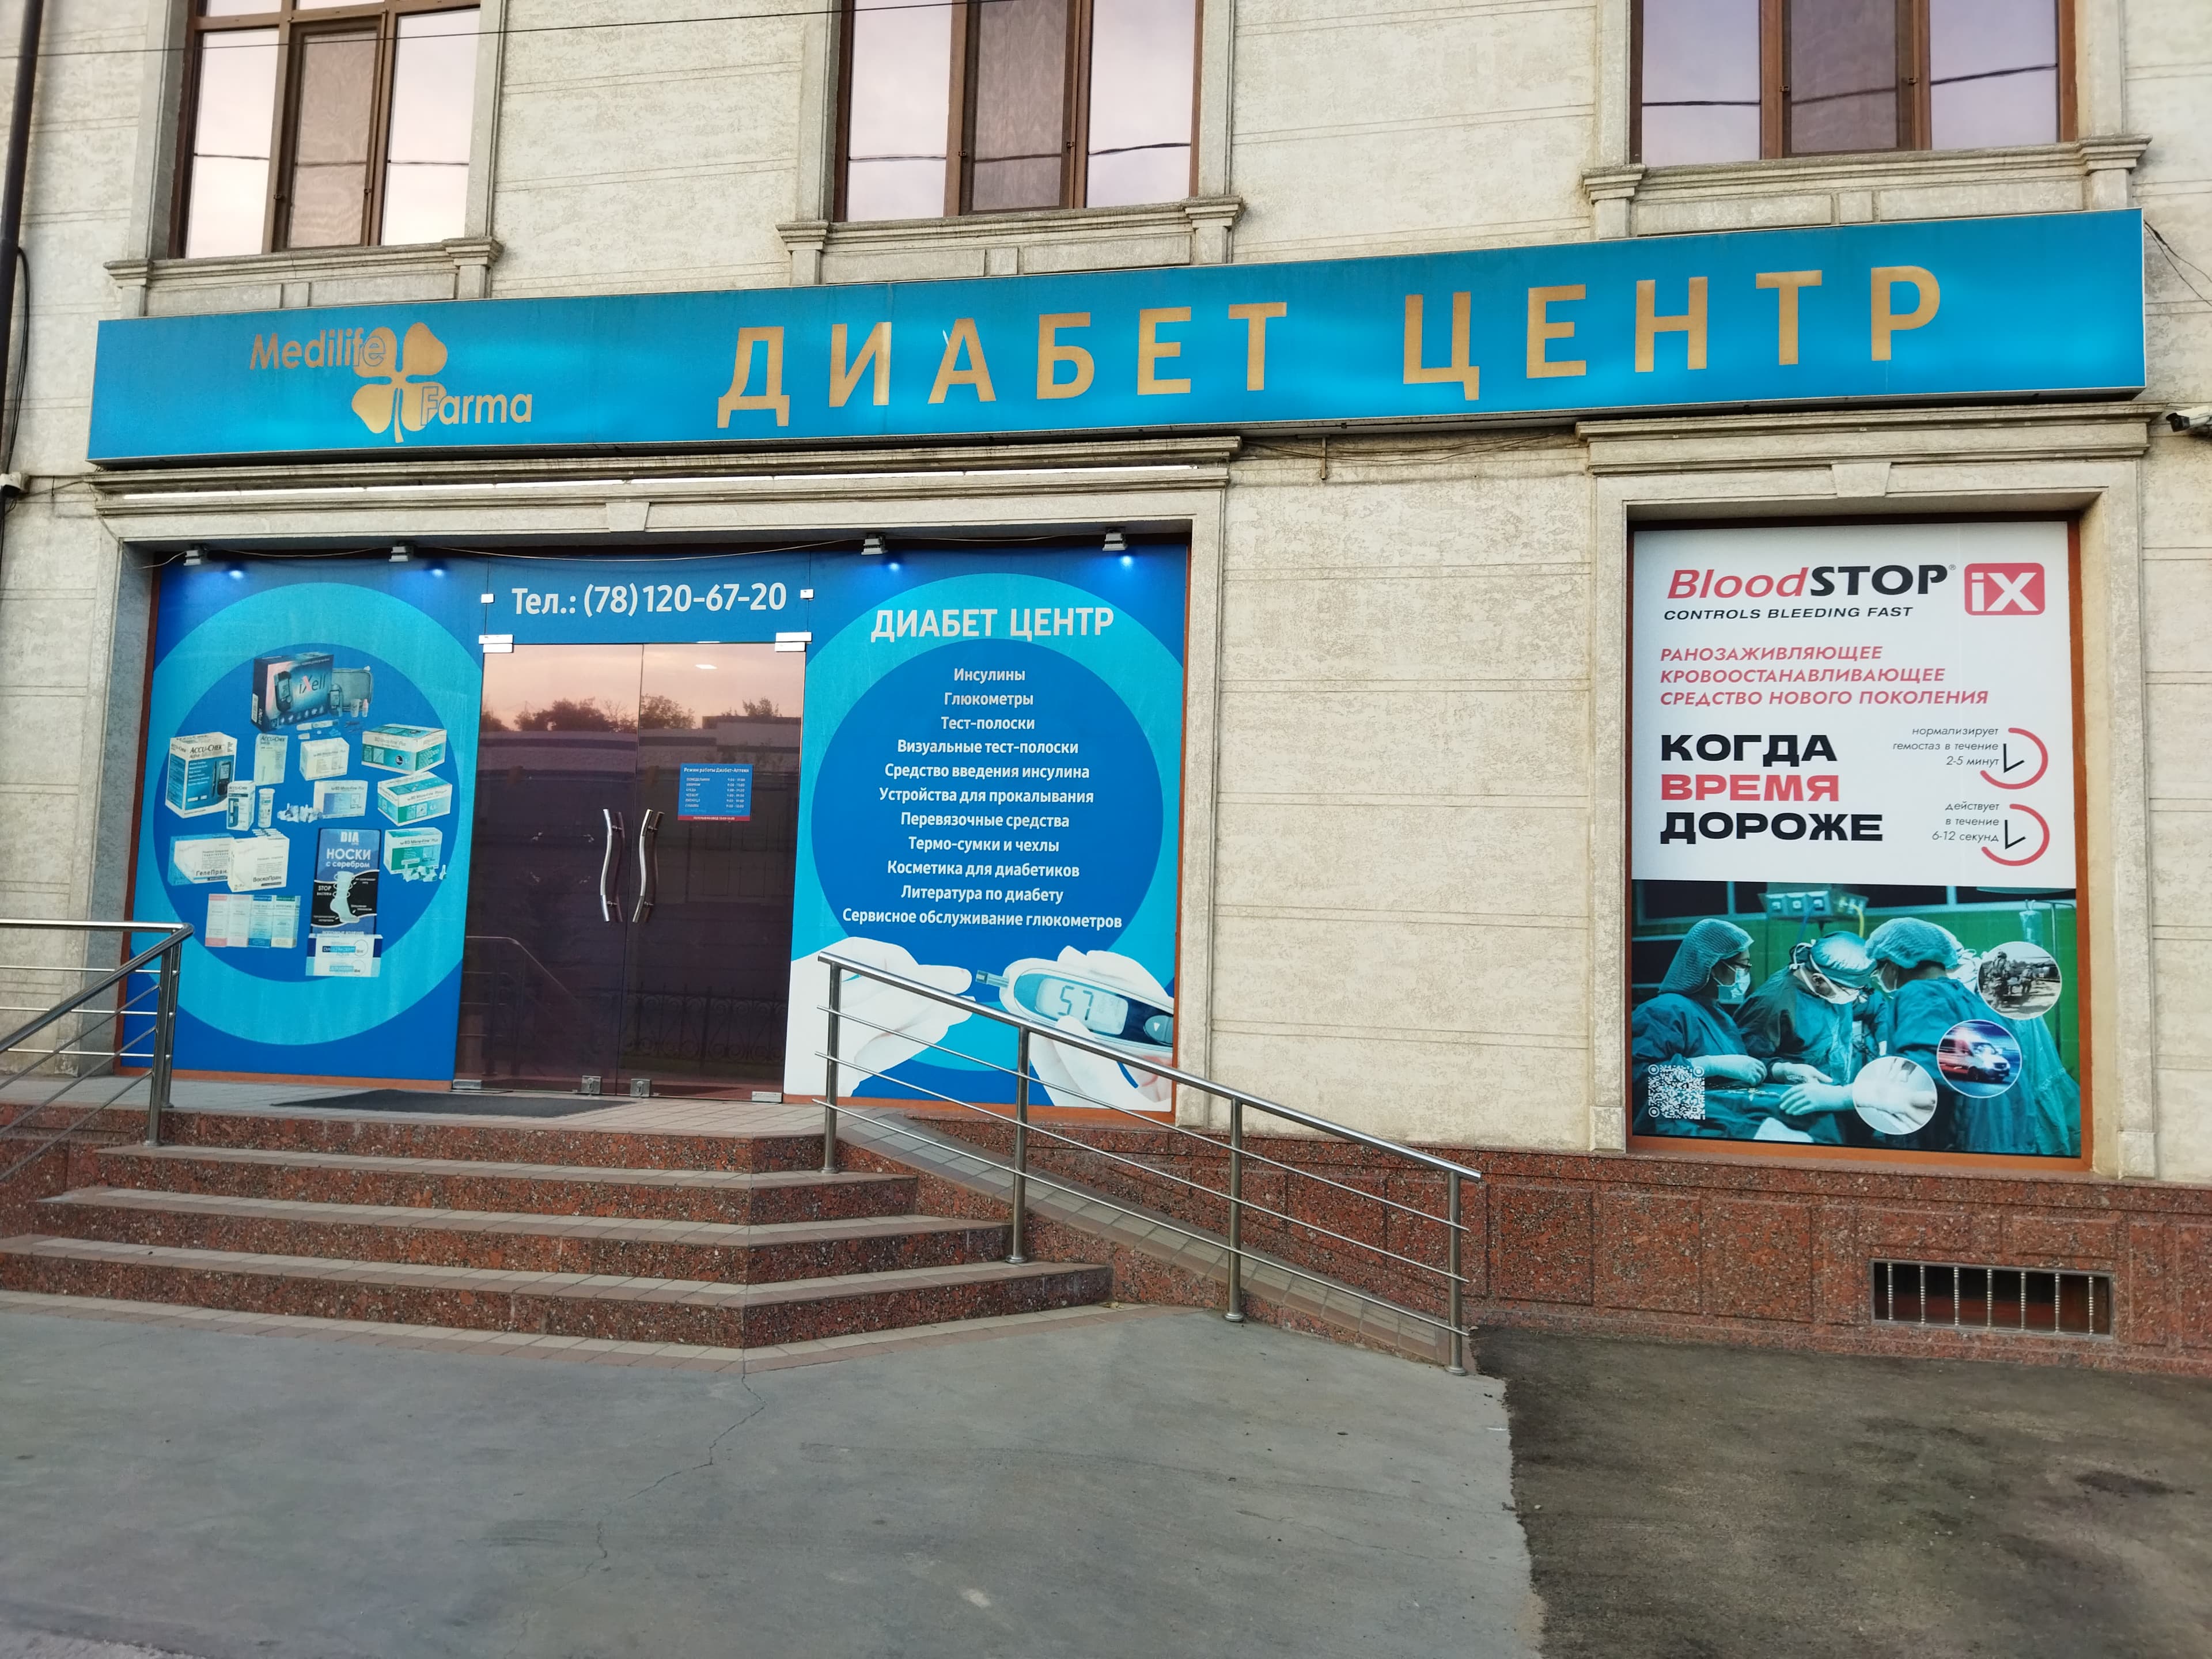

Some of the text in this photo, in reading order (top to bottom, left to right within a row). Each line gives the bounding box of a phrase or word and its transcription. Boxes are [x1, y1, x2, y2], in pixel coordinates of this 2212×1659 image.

[249, 326, 387, 370] Medilife
[717, 264, 1941, 429] ДИАБЕТ ЦЕНТР
[421, 385, 532, 426] Farma
[512, 588, 576, 615] Тел.:
[1664, 607, 1913, 620] CONTROLS BLEEDING FAST
[870, 607, 1115, 643] ДИАБЕТ ЦЕНТР
[1660, 646, 1883, 662] РАНОЗАЖИВЛЯЮЩЕЕ
[954, 668, 1025, 683] Инсулины
[1660, 668, 1945, 684] КРОВООСТАНАВЛИВАЮЩЕЕ
[299, 675, 325, 694] iXell
[944, 692, 1034, 707] Глюкометры
[1660, 691, 1988, 706] СРЕДСТВО НОВОГО ПОКОЛЕНИЯ
[941, 717, 1035, 730] Тест-полоски
[1912, 728, 1998, 738] нормализирует
[190, 744, 222, 754] ACCU-CHEK
[897, 740, 1078, 755] Визуальные тест-полоски
[1661, 734, 1837, 767] КОГДА
[1893, 743, 1998, 751] гемостаз в течение
[1946, 756, 1999, 768] 2-5 минут
[885, 763, 1089, 780] Средство введения инсулина
[879, 787, 1094, 804] Устройства для прокалывания
[1661, 774, 1839, 801] ВРЕМЯ
[1945, 801, 1999, 813] действует
[900, 812, 1070, 829] Перевязочные средства
[1660, 812, 1883, 844] ДОРОЖЕ
[340, 832, 359, 843] DIA
[908, 836, 1059, 852] Термо-сумки и чехлы
[1932, 832, 1999, 843] 6-12 секунд
[327, 849, 371, 861] НОСКИ
[887, 861, 1080, 877] Косметика для диабетиков
[900, 885, 1063, 904] Литература по диабету
[842, 908, 1122, 929] Сервисное обслуживание глюкометров
